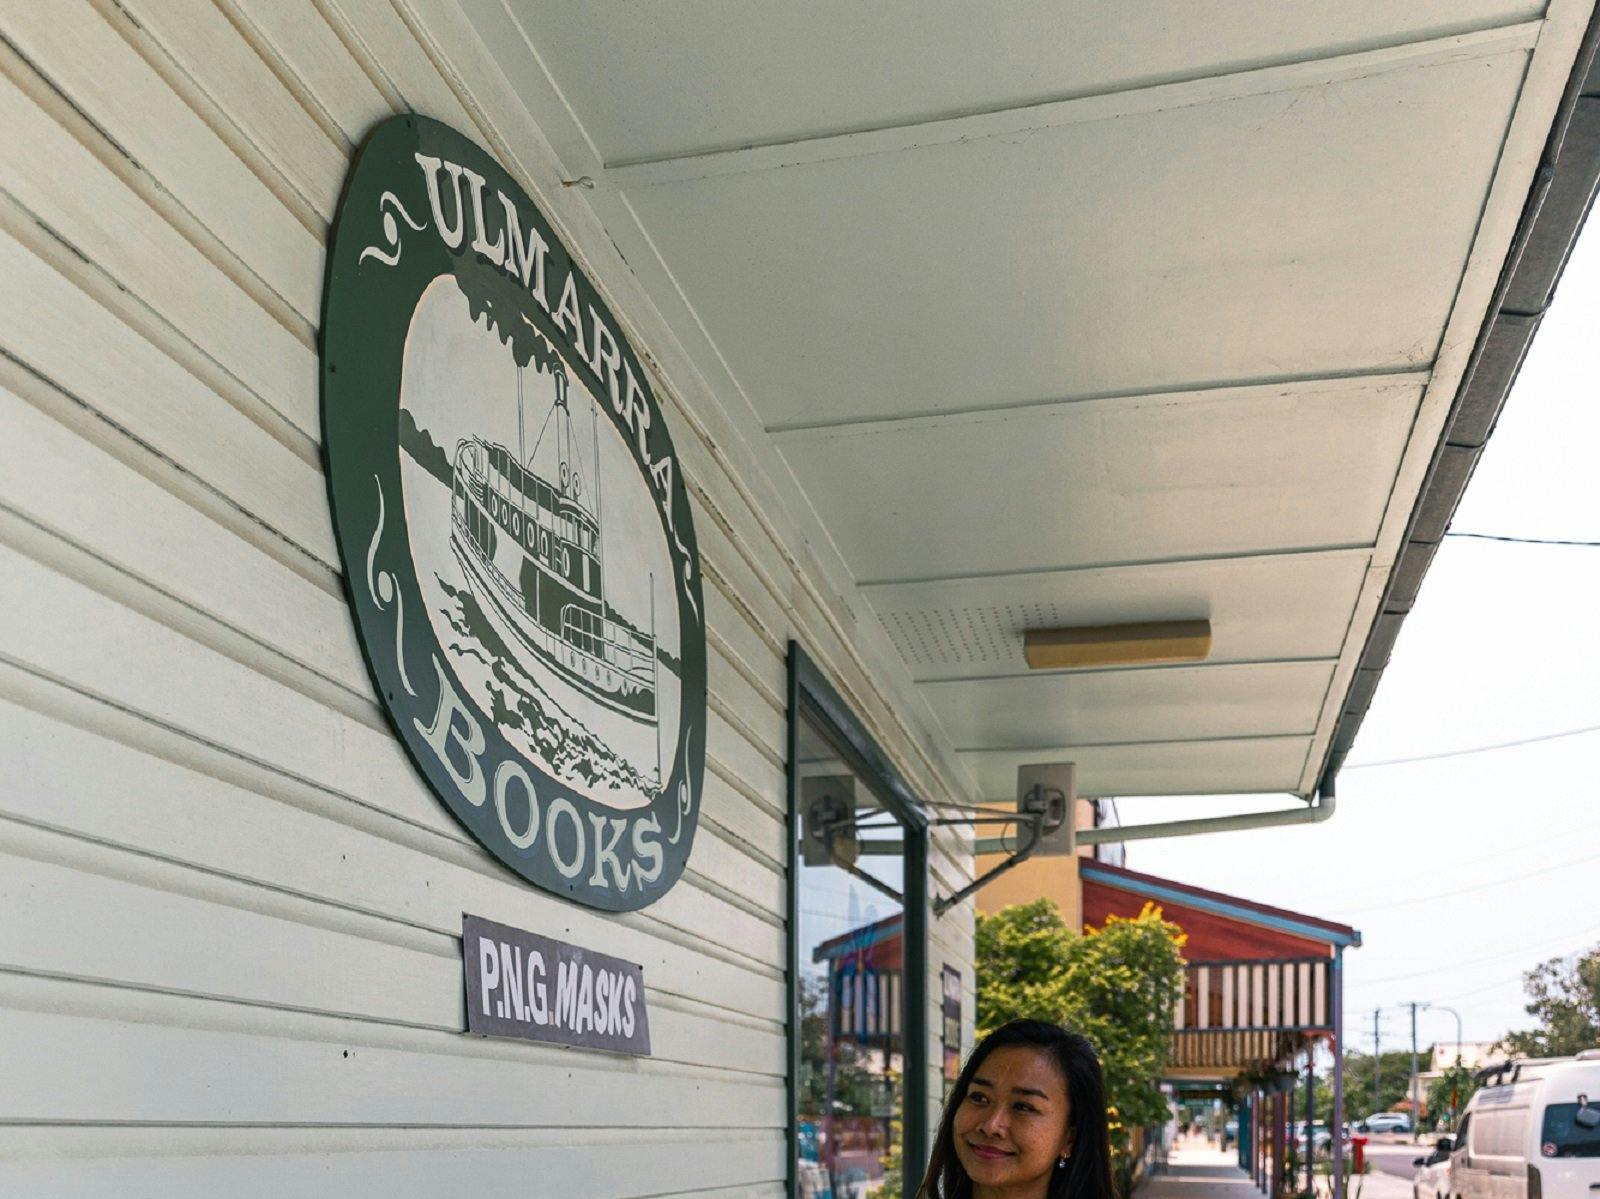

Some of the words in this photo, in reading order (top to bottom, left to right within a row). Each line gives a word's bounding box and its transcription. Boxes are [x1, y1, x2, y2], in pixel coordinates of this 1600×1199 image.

[414, 151, 673, 532] ULMARRA
[413, 652, 665, 893] BOOKS
[554, 959, 637, 1039] MASKS
